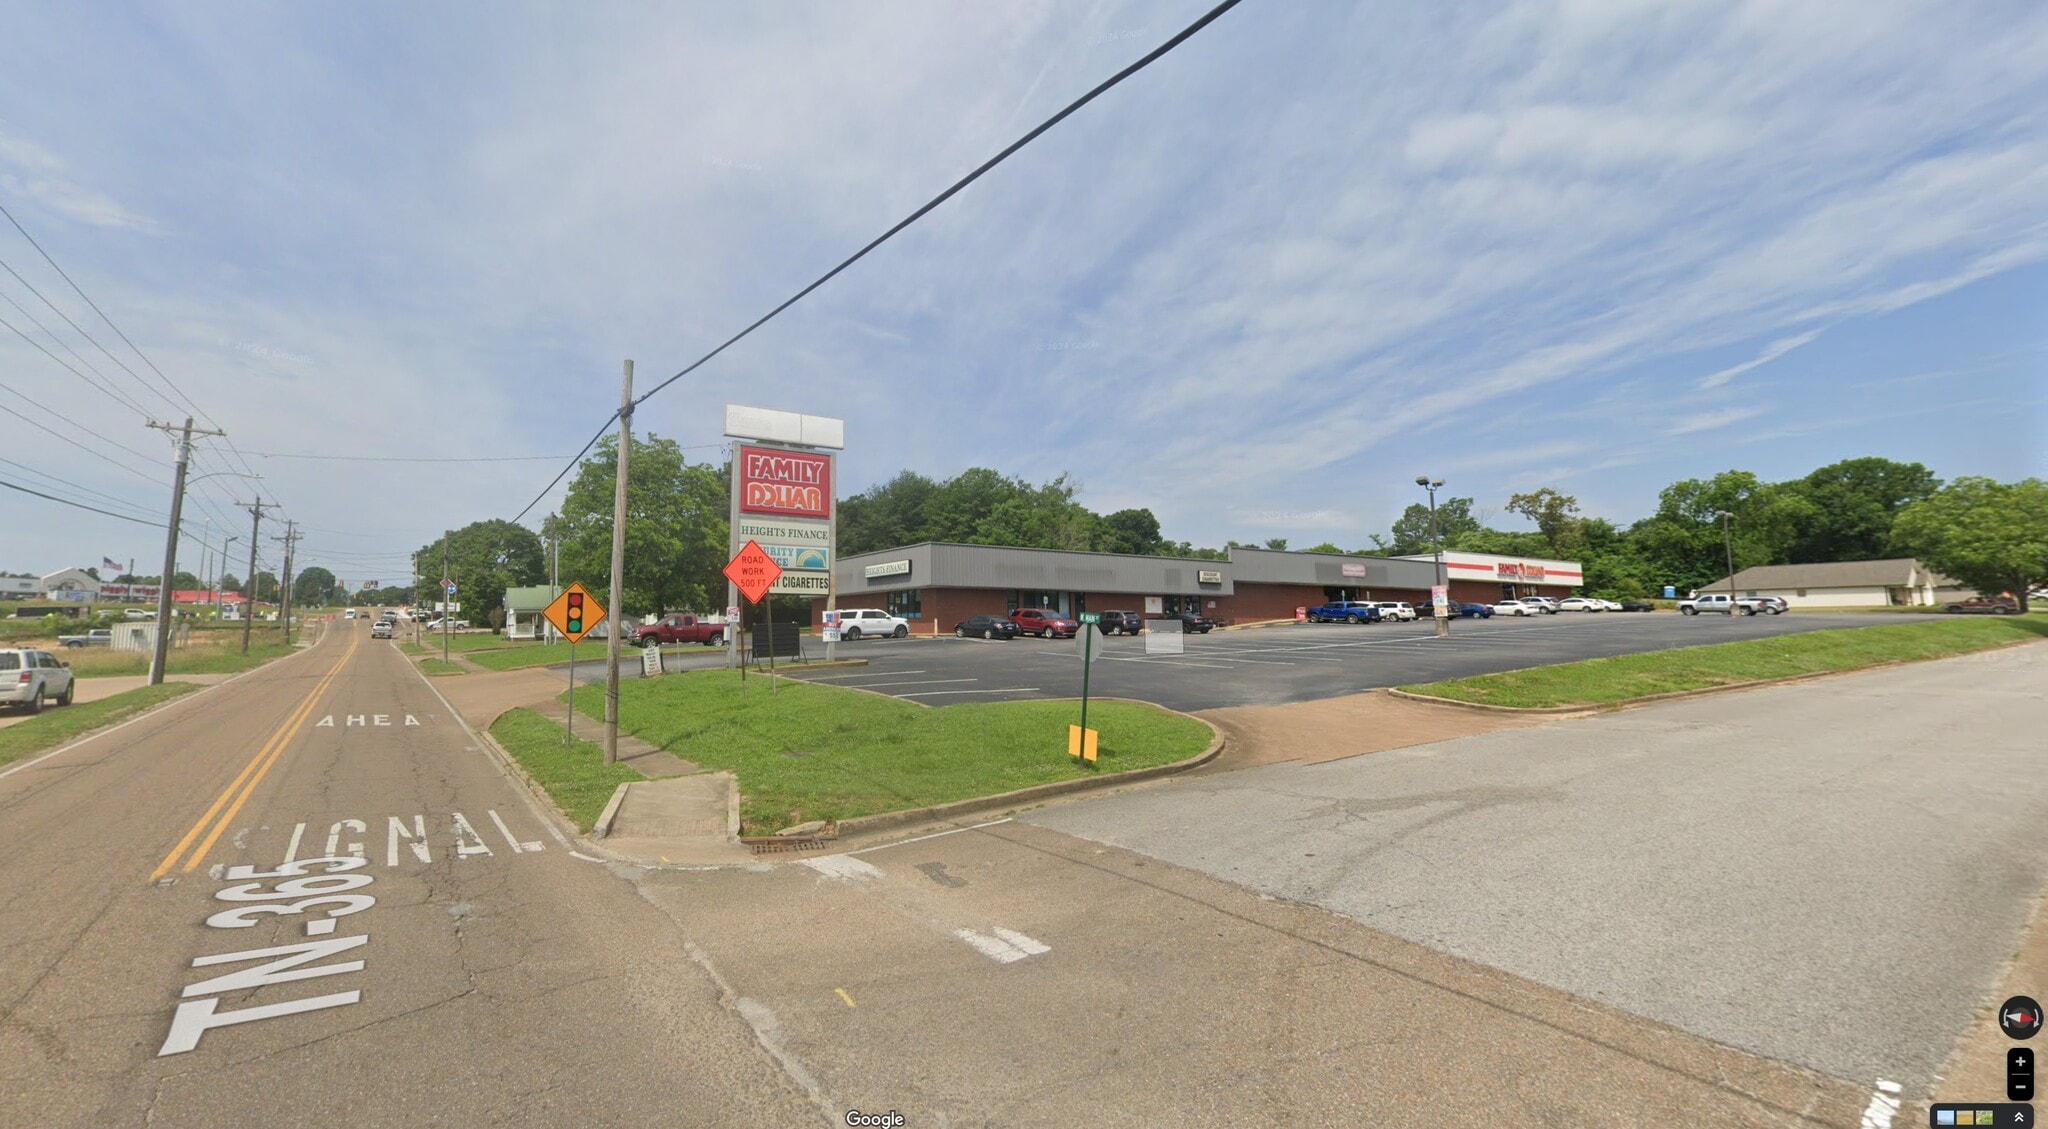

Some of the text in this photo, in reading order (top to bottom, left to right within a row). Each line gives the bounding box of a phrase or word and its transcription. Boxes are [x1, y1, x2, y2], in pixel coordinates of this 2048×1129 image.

[748, 454, 824, 484] FAMILY
[747, 481, 822, 511] DOLLAR
[741, 525, 828, 540] HEIGHTS FINANCE
[763, 547, 794, 557] URITY
[741, 555, 764, 564] ROAD
[741, 567, 765, 576] WORK
[1498, 563, 1517, 575] FAMILY
[740, 579, 754, 588] 500
[757, 579, 766, 587] FT
[782, 576, 829, 589] CIGARETTES
[315, 714, 438, 727] AHEA
